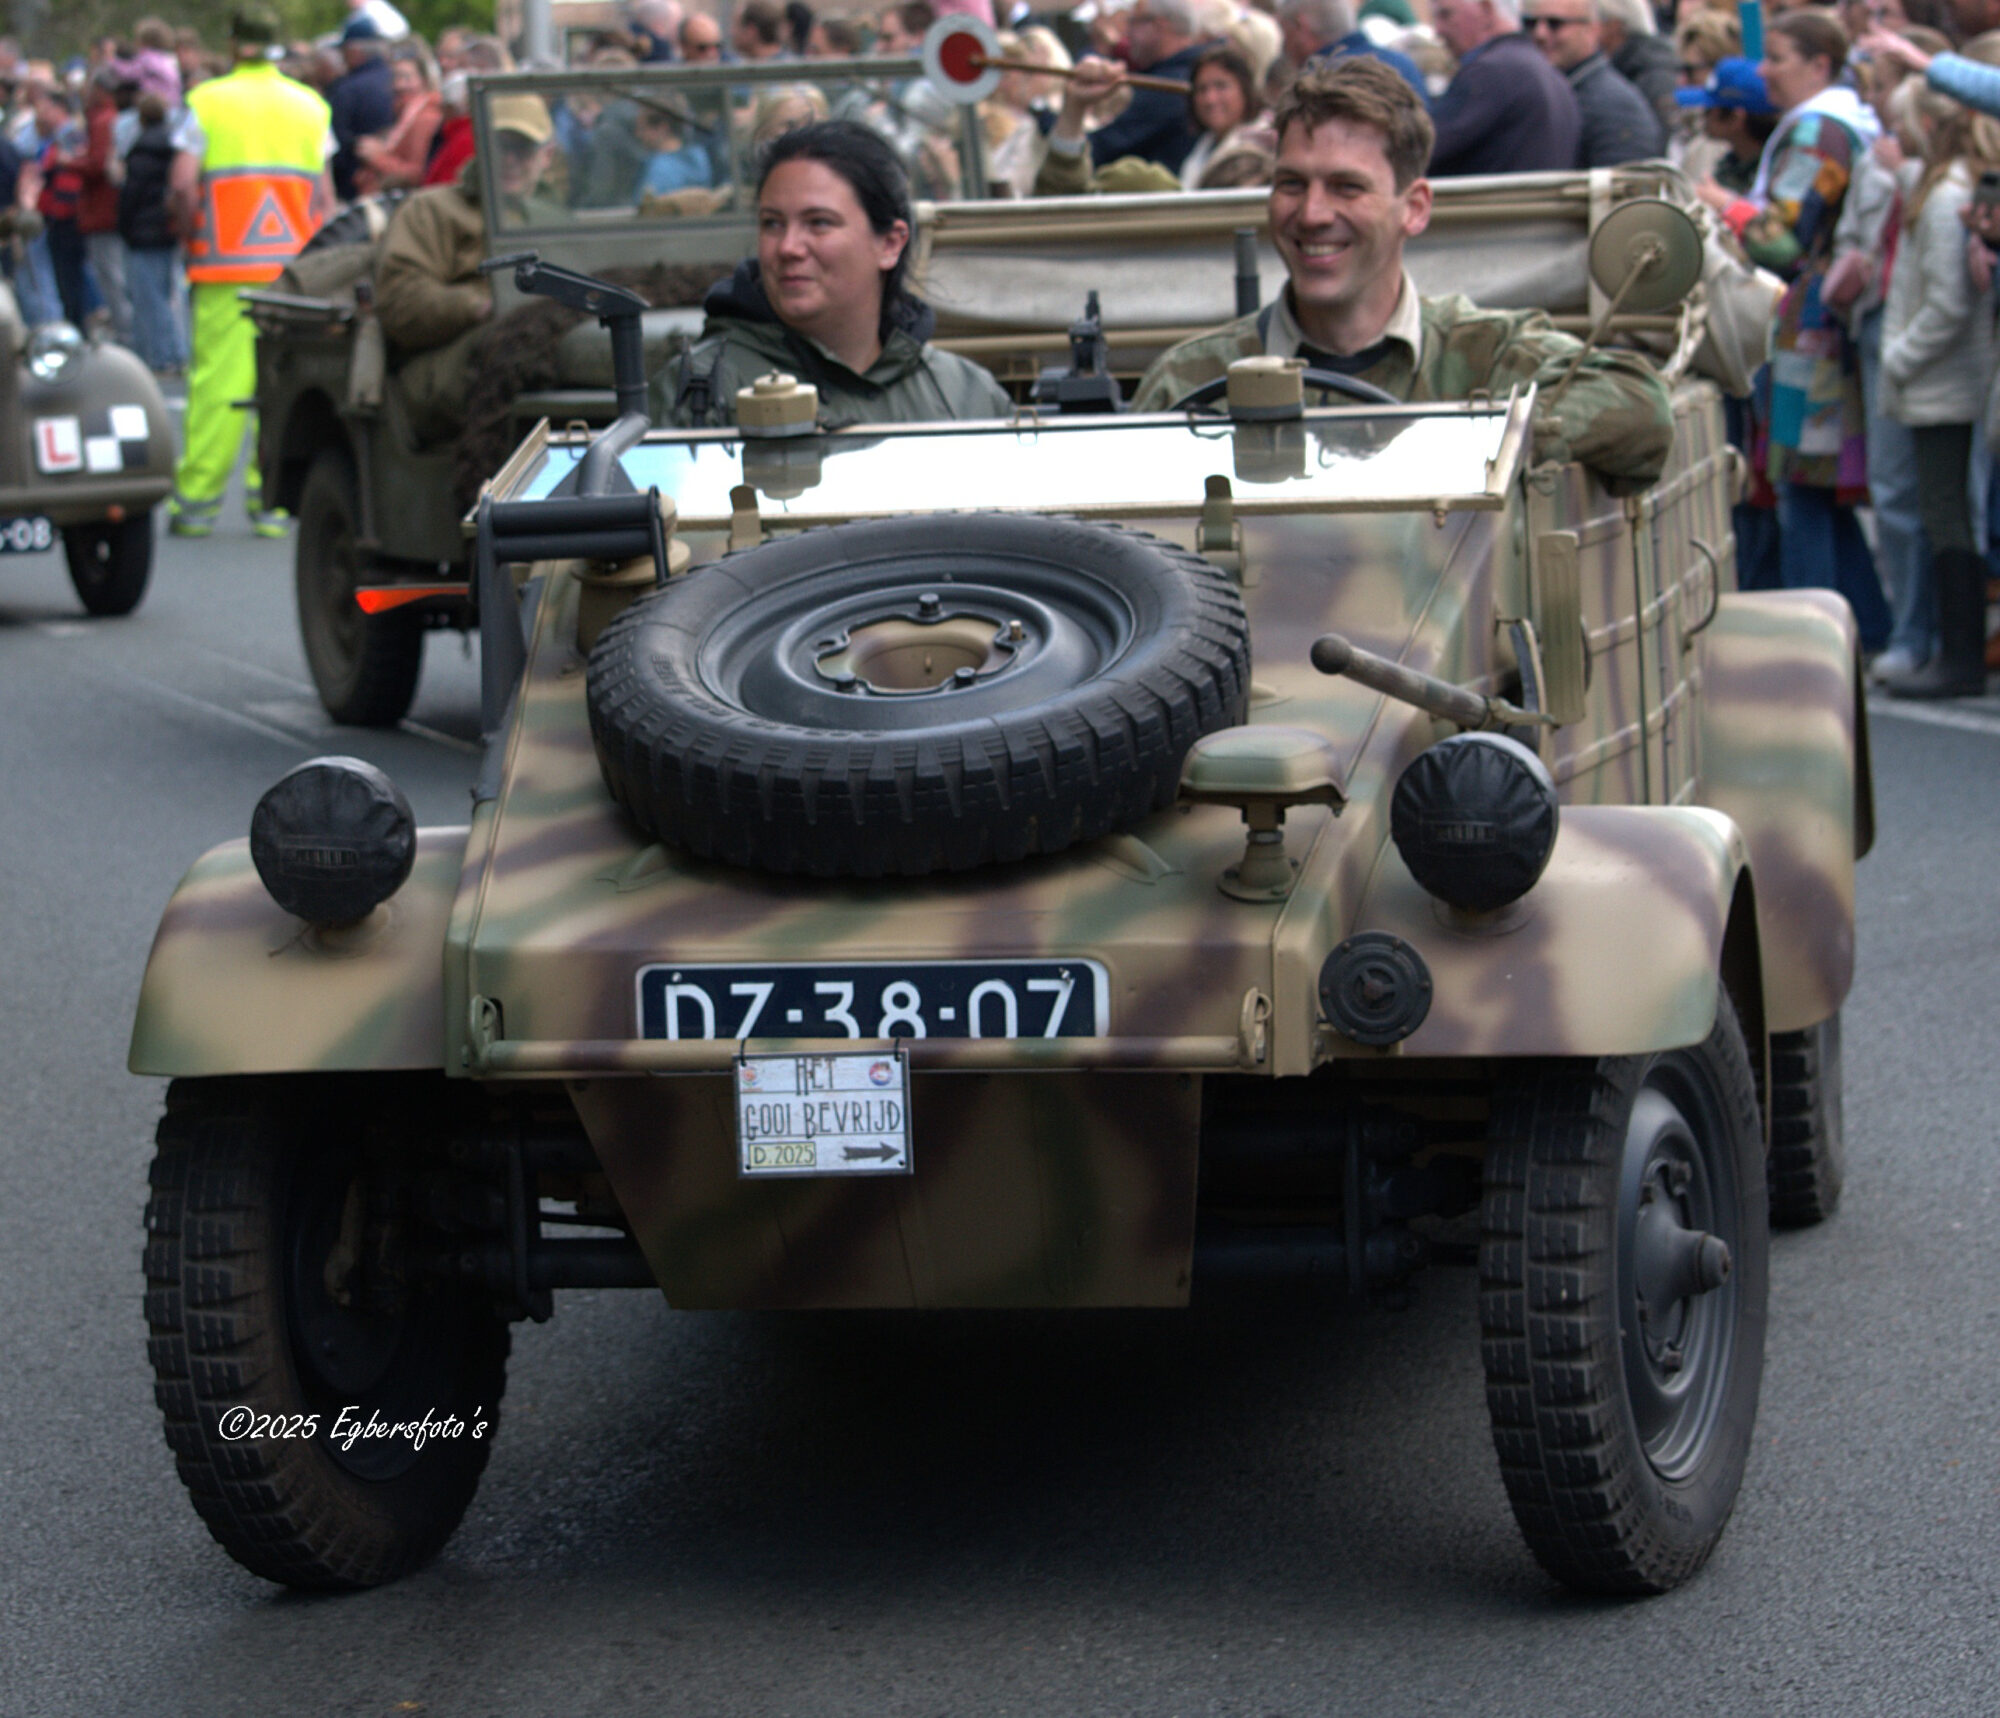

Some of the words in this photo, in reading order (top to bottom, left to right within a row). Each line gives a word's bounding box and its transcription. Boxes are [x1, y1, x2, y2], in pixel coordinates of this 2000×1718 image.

[45, 423, 77, 464] L
[795, 1057, 836, 1097] HET
[746, 1102, 791, 1140] GOOI
[803, 1100, 901, 1139] BEVRIJD
